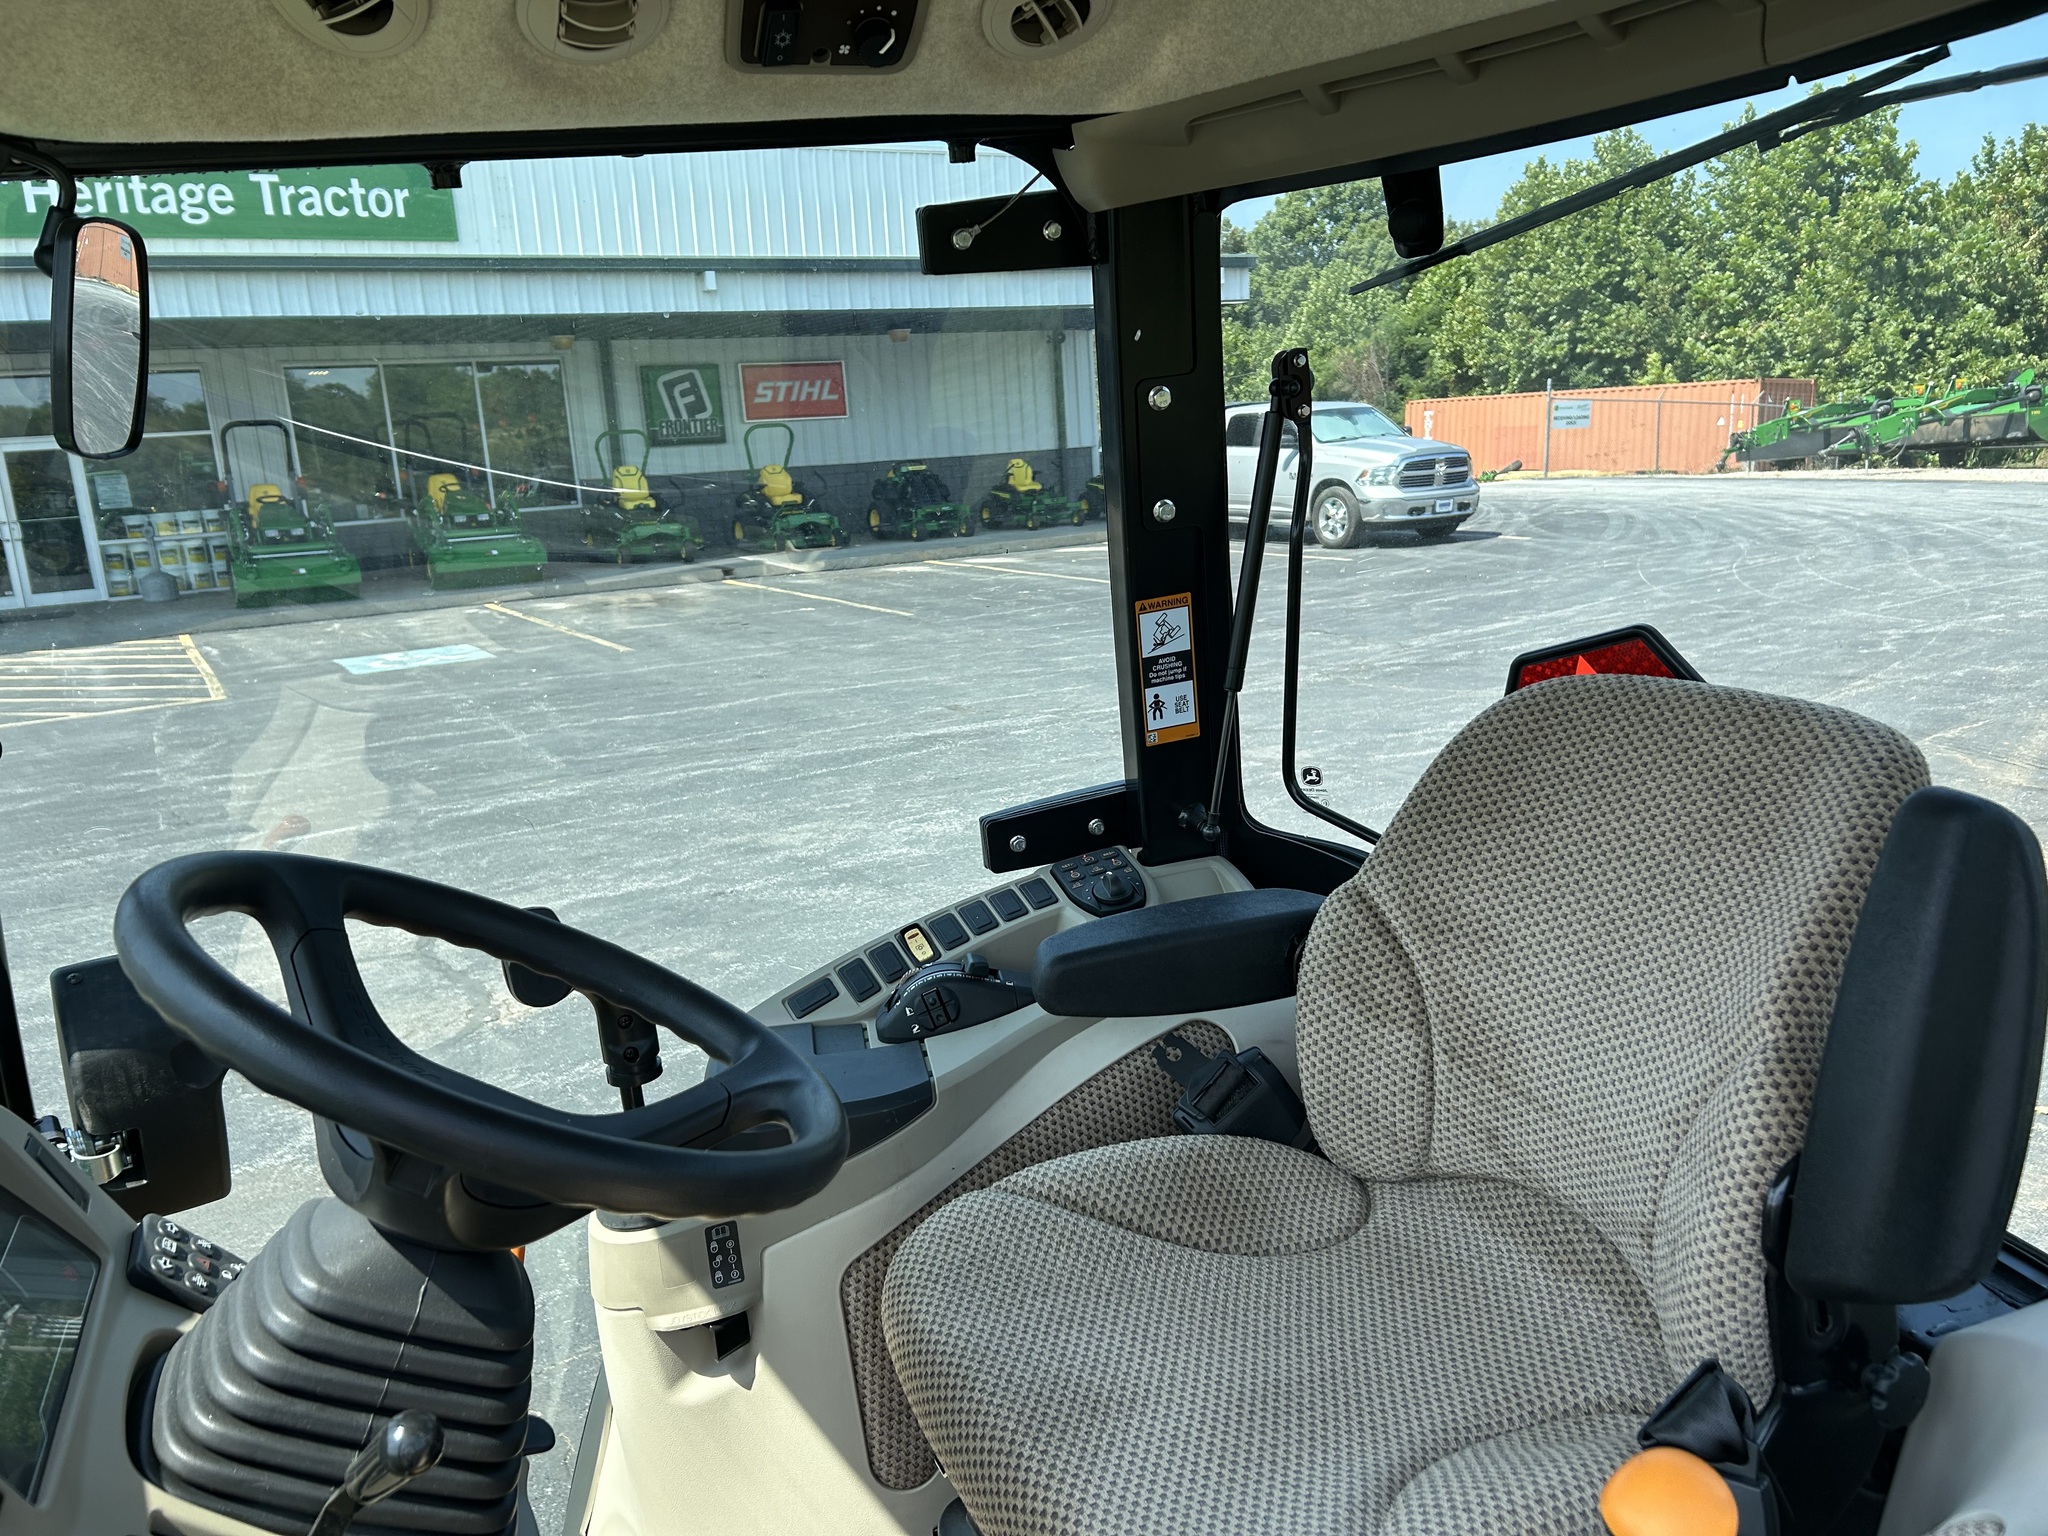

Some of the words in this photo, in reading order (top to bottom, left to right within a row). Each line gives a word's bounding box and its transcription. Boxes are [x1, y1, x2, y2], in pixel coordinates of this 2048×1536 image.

[21, 174, 235, 225] Heritage
[248, 173, 409, 219] Tractor
[753, 379, 840, 404] STIHL
[659, 417, 719, 439] FRONTIER
[1147, 596, 1189, 610] WARNING
[1158, 655, 1176, 664] AVOID
[1152, 660, 1183, 672] CRUSHING
[1168, 667, 1182, 676] jump
[1151, 676, 1175, 684] machine
[1175, 694, 1188, 702] USE
[1175, 706, 1190, 714] BELT
